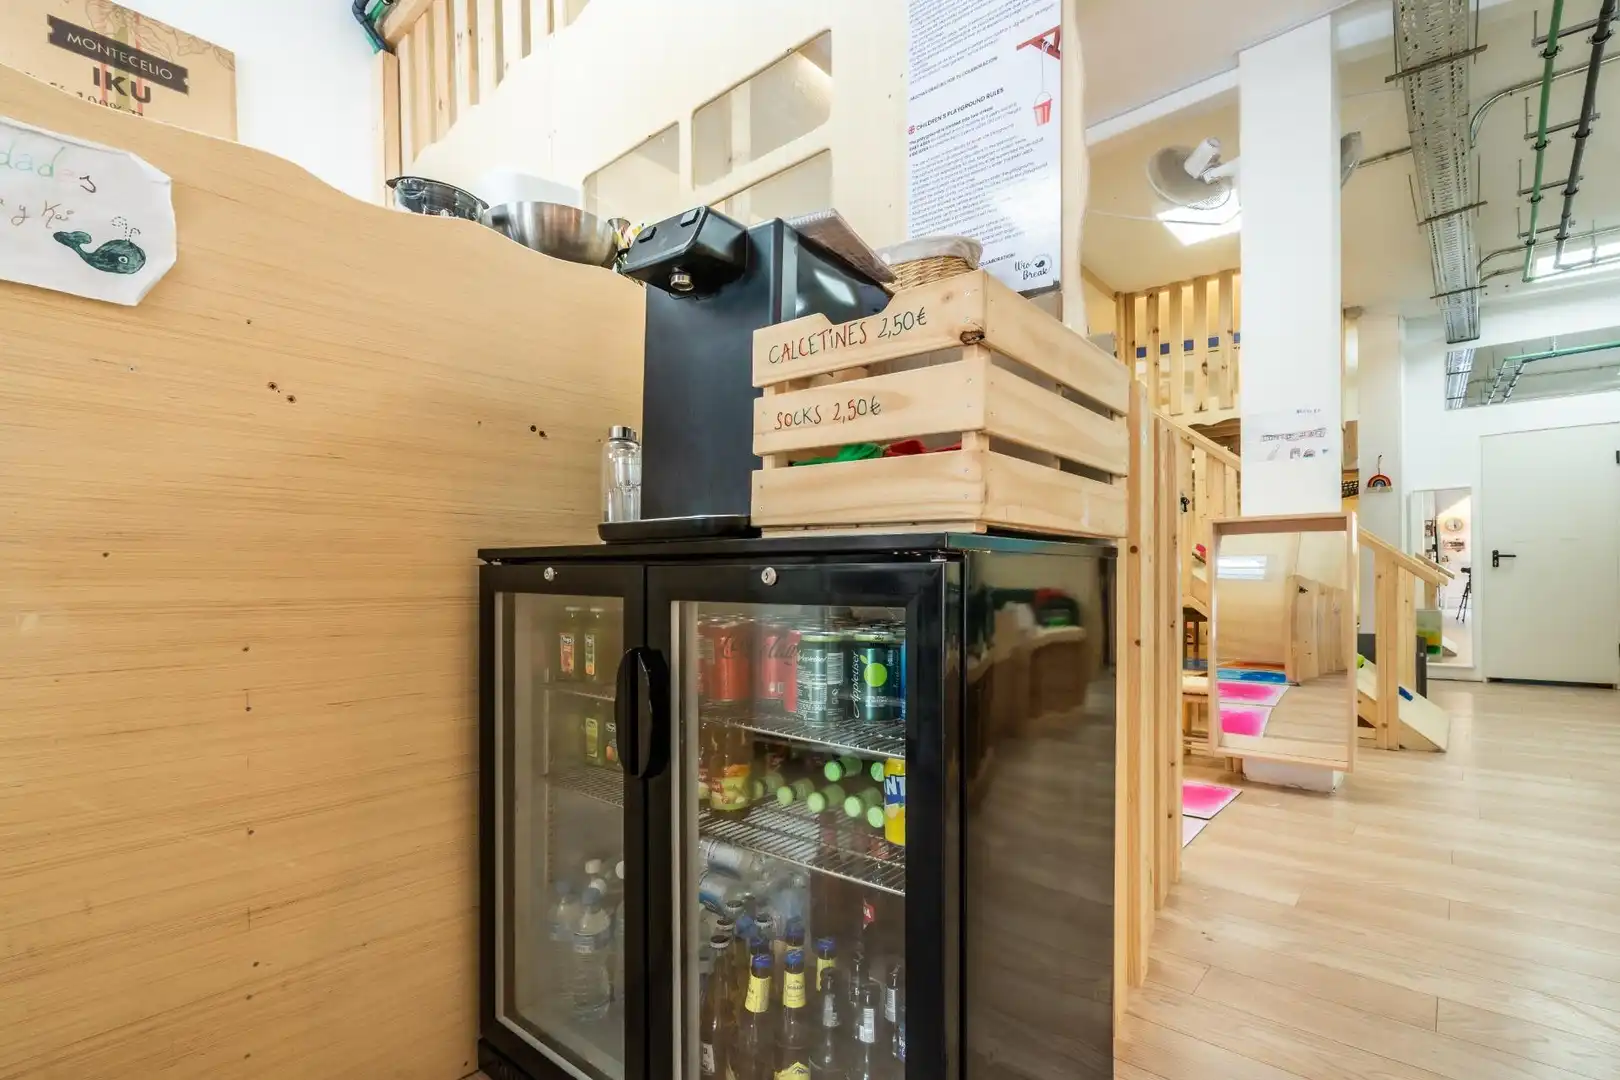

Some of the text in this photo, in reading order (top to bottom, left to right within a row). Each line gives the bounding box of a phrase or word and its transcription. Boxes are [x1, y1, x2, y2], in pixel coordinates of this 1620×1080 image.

[67, 32, 173, 80] MONTECELIO
[93, 66, 151, 104] IKU
[947, 95, 985, 118] PLAYGROUND
[986, 86, 1004, 100] RULES
[1022, 267, 1048, 280] Break
[768, 306, 928, 364] CALCETINES 2,50€
[774, 395, 881, 430] SOCKS 2,50€
